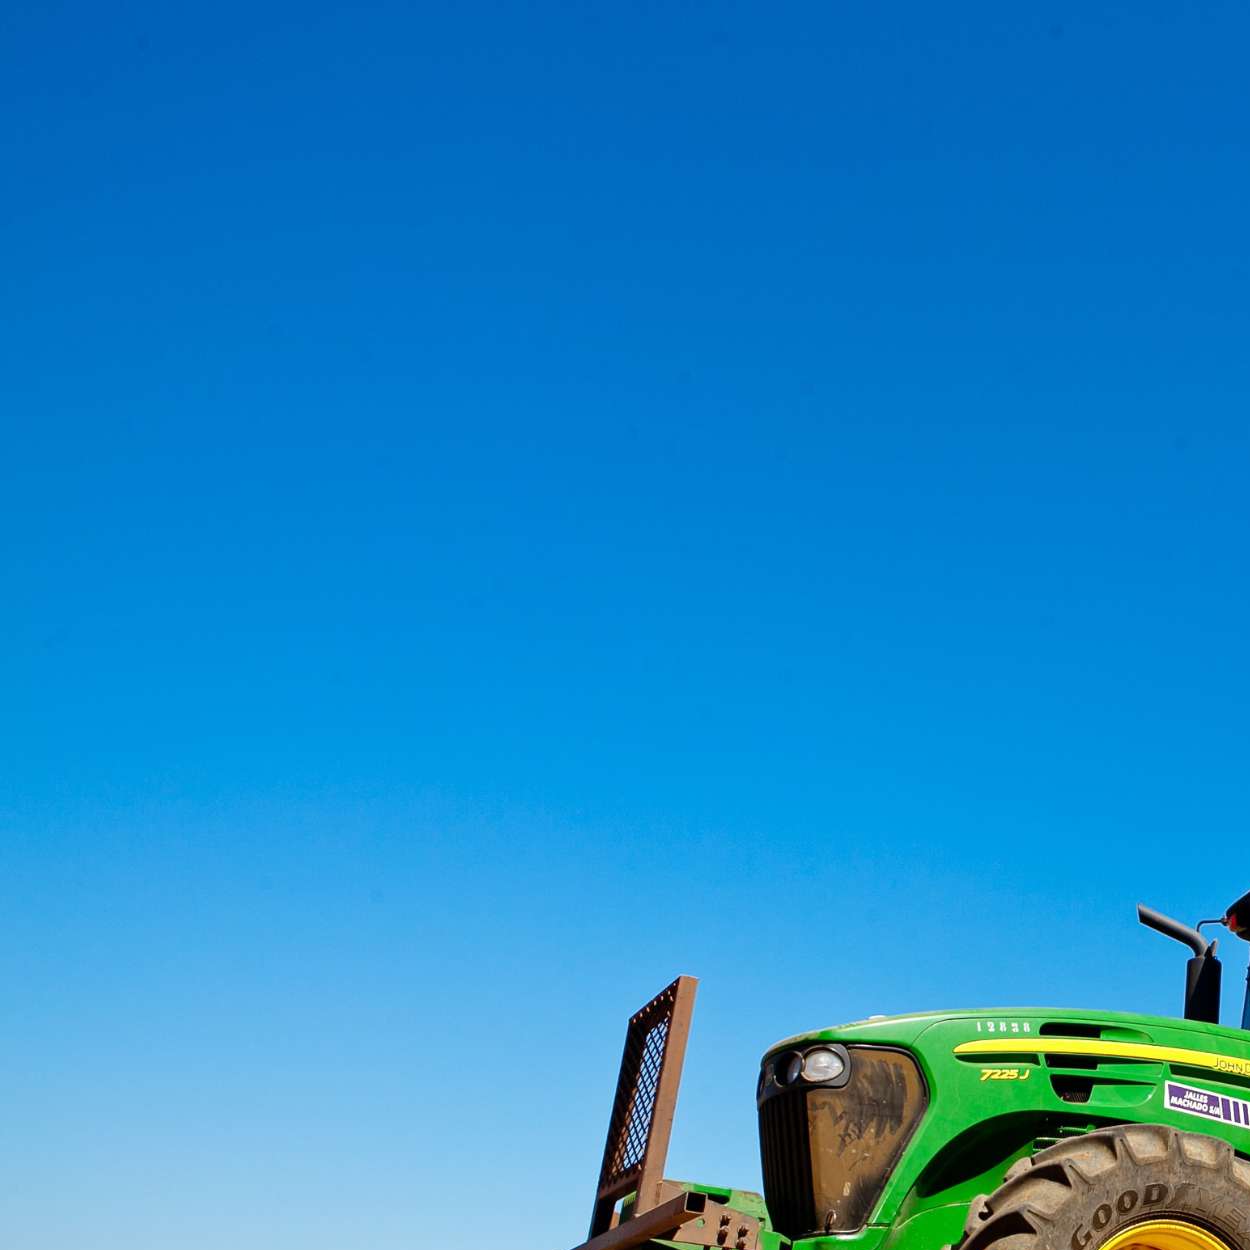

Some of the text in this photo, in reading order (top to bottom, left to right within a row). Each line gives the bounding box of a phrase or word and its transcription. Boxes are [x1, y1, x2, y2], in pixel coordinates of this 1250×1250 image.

[1213, 1057, 1243, 1073] JOHN
[1170, 1096, 1209, 1112] MACHADO
[1183, 1090, 1209, 1104] JALLES
